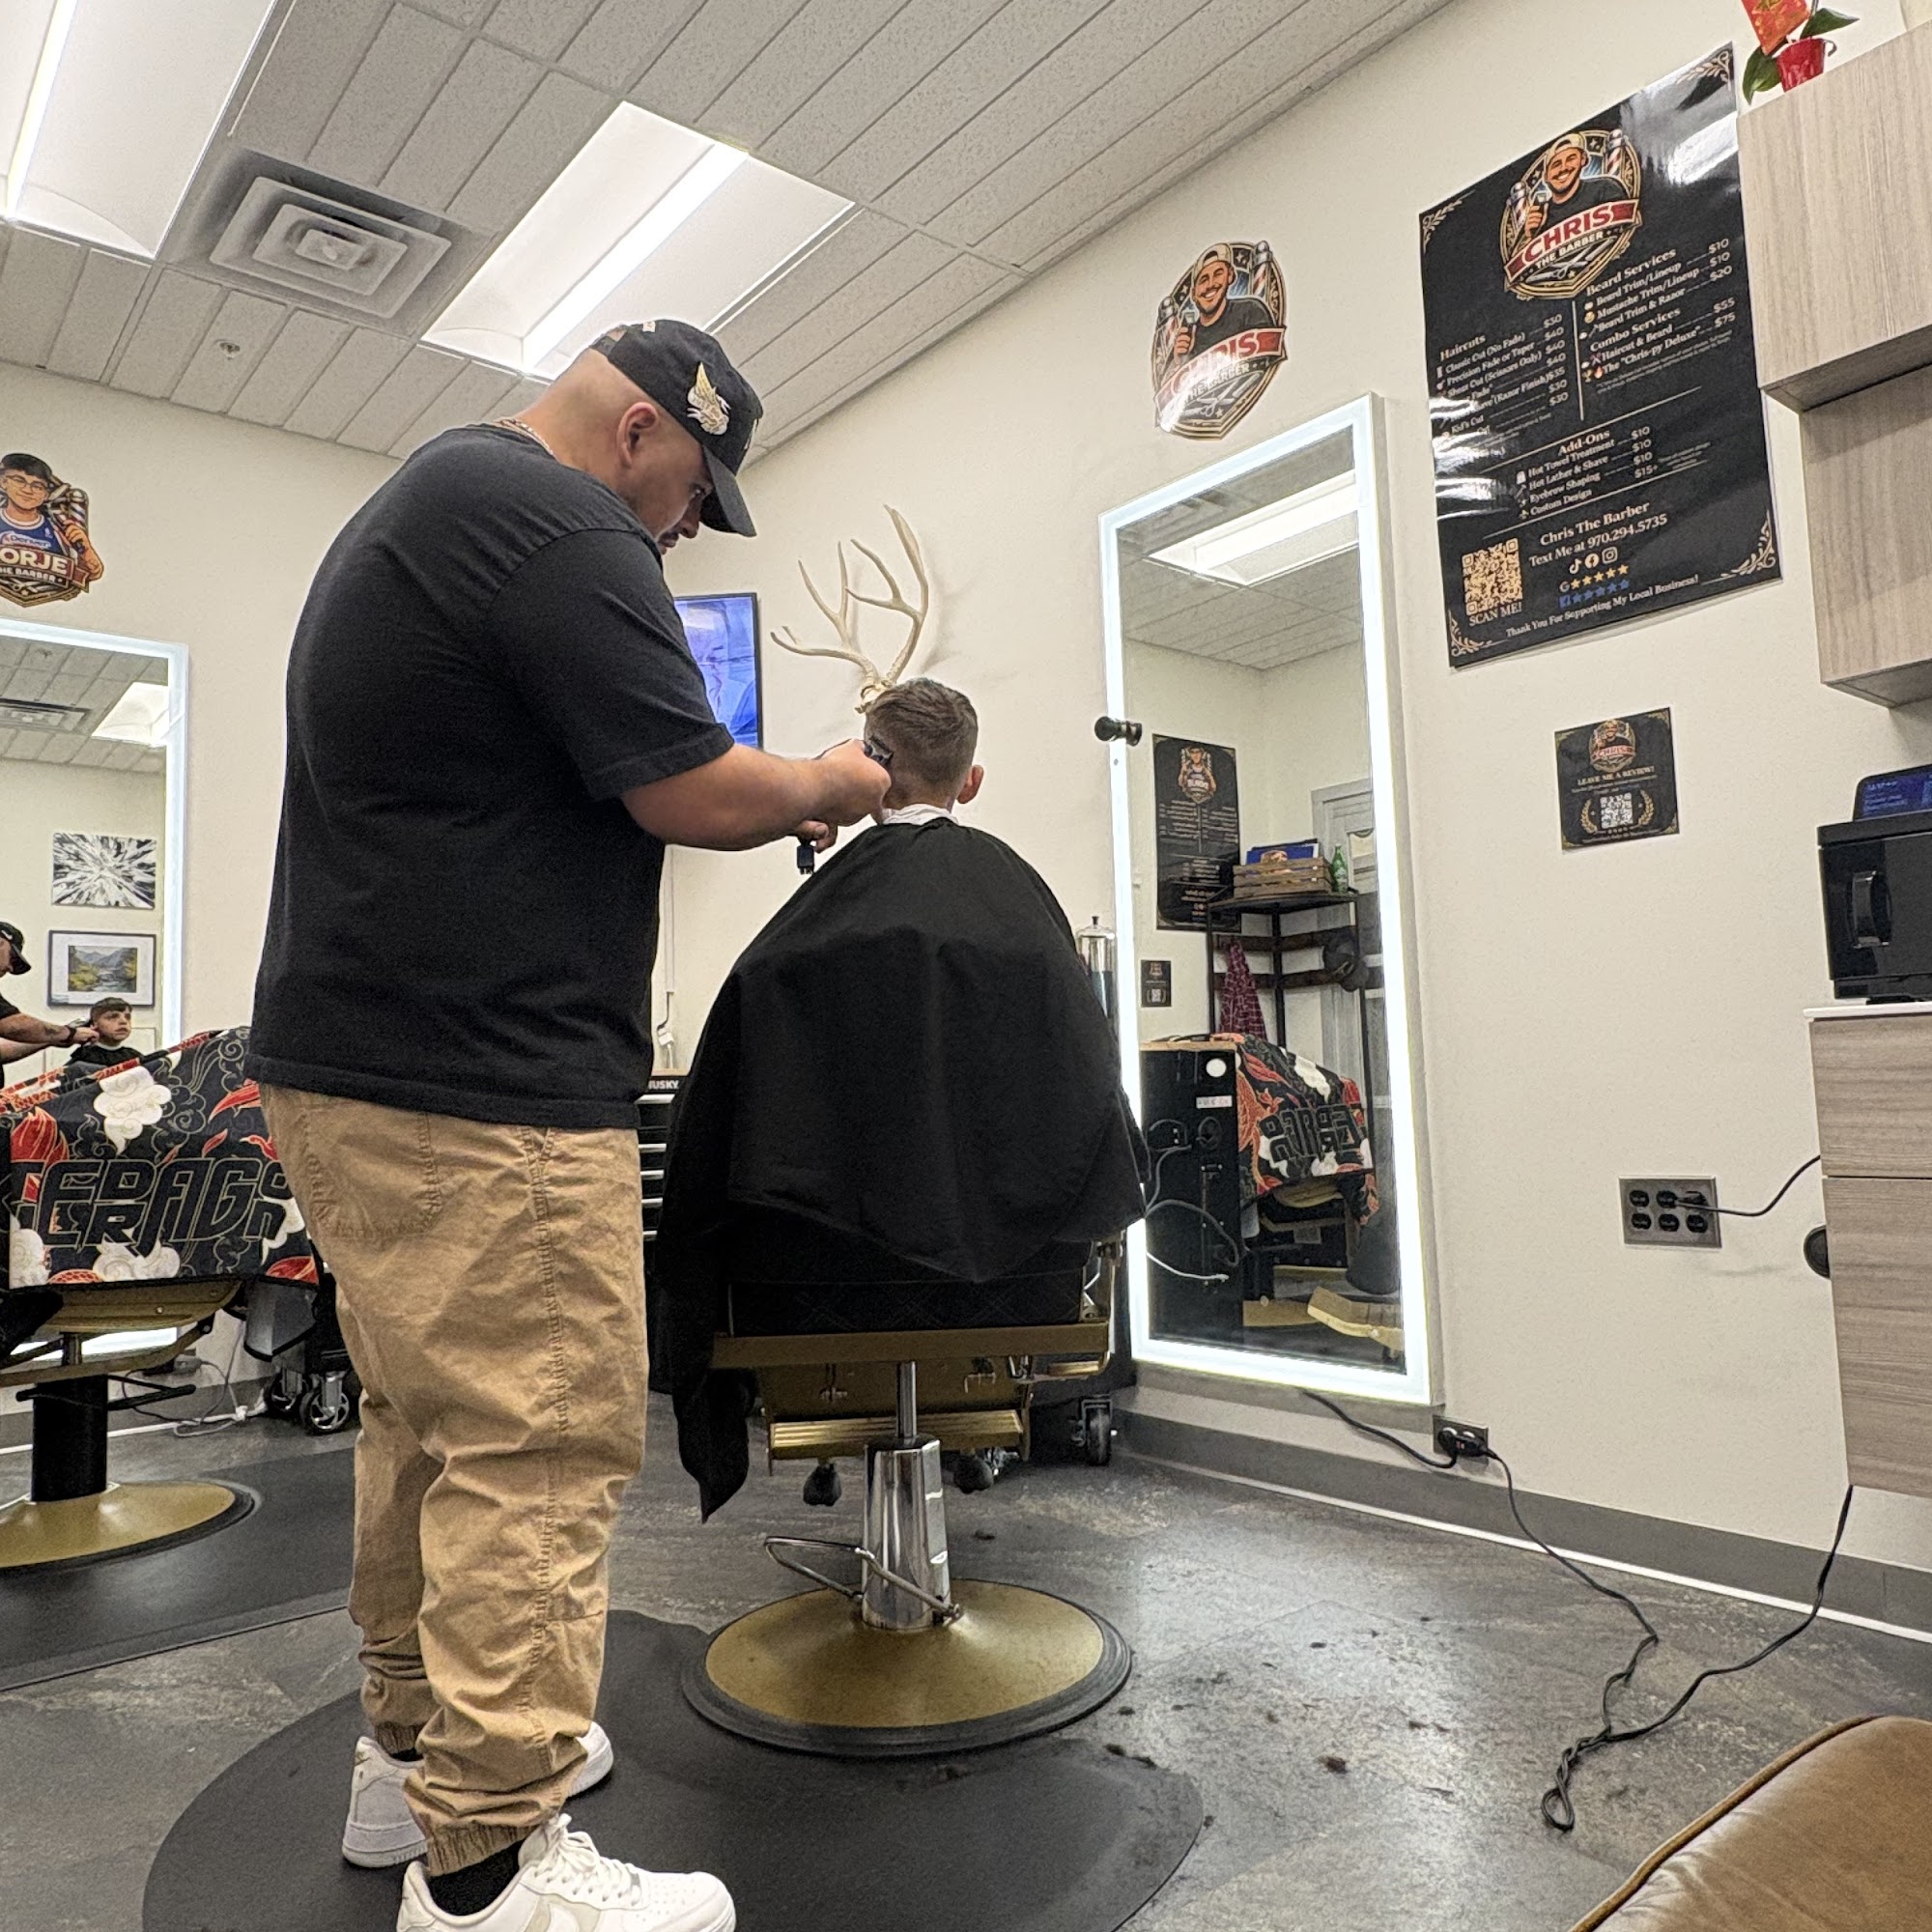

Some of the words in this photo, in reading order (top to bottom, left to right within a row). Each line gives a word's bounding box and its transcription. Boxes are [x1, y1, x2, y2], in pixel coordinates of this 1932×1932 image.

[1524, 205, 1611, 263] CHRIS
[1536, 253, 1556, 270] THE
[1559, 231, 1604, 257] BARBER
[1585, 272, 1621, 296] Beard
[1625, 249, 1676, 278] Services
[1597, 287, 1621, 305] Beard
[1623, 263, 1681, 293] Trim/Lineup
[1708, 239, 1729, 254] $10
[1598, 296, 1638, 319] Mustache
[1640, 269, 1699, 298] Trim/Lineup
[1710, 252, 1730, 267] $10
[1598, 313, 1623, 331] Beard
[1625, 305, 1647, 319] Trim
[1649, 300, 1657, 309] &
[1659, 288, 1685, 305] Razor
[1710, 266, 1732, 281] $20
[1440, 336, 1486, 361] Haircuts
[1446, 357, 1470, 373] Classic
[1472, 351, 1486, 361] Cut
[1487, 345, 1502, 355] (No
[1503, 332, 1524, 348] Fade)
[1544, 314, 1562, 328] $30
[1590, 330, 1630, 352] Combo
[1632, 309, 1680, 334] Services
[1602, 342, 1634, 361] Haircut
[1646, 325, 1672, 342] Beard
[1714, 298, 1735, 313] $55
[1604, 362, 1619, 373] The
[1715, 312, 1735, 327] $75
[1173, 331, 1257, 394] CRIS
[1447, 367, 1481, 385] Precision
[1482, 357, 1500, 371] Fade
[1512, 342, 1534, 356] Taper
[1545, 327, 1564, 341] $40
[1470, 377, 1484, 387] Cut
[1485, 363, 1519, 383] (Scissors
[1520, 351, 1542, 366] Only)
[1546, 340, 1565, 354] $40
[1547, 353, 1566, 367] $40
[1470, 415, 1484, 425] Cut
[1548, 380, 1567, 393] $30
[1549, 392, 1569, 406] $30
[1528, 467, 1544, 477] Hot
[1544, 455, 1569, 470] Towel
[1570, 440, 1614, 461] Treatment
[1632, 427, 1650, 440] $10
[1529, 479, 1545, 491] Hot
[1546, 469, 1572, 484] Lather
[1582, 456, 1607, 470] Shave
[1633, 439, 1651, 452] $10
[1558, 431, 1609, 456] Add-Ons
[1530, 486, 1565, 502] Eyebrow
[1566, 472, 1600, 490] Shaping
[1634, 452, 1652, 466] $10
[1530, 500, 1561, 515] Custom
[1563, 489, 1592, 504] Design
[1634, 466, 1658, 478] $15+
[1529, 553, 1552, 566] Text
[1555, 547, 1573, 558] Me
[1575, 542, 1585, 553] at
[1588, 514, 1667, 549] 970.294.5735
[1541, 527, 1574, 545] Chris
[1576, 520, 1601, 533] The
[1604, 502, 1649, 526] Barber
[15, 568, 56, 582] BARBER
[1468, 610, 1498, 627] SCAN
[1500, 602, 1522, 620] ME!
[1506, 623, 1531, 637] Thank
[1532, 620, 1548, 629] You
[1549, 614, 1563, 625] For
[1565, 601, 1611, 619] Supporting
[1613, 596, 1627, 606] My
[1629, 586, 1653, 601] Local
[1655, 574, 1698, 594] Business!
